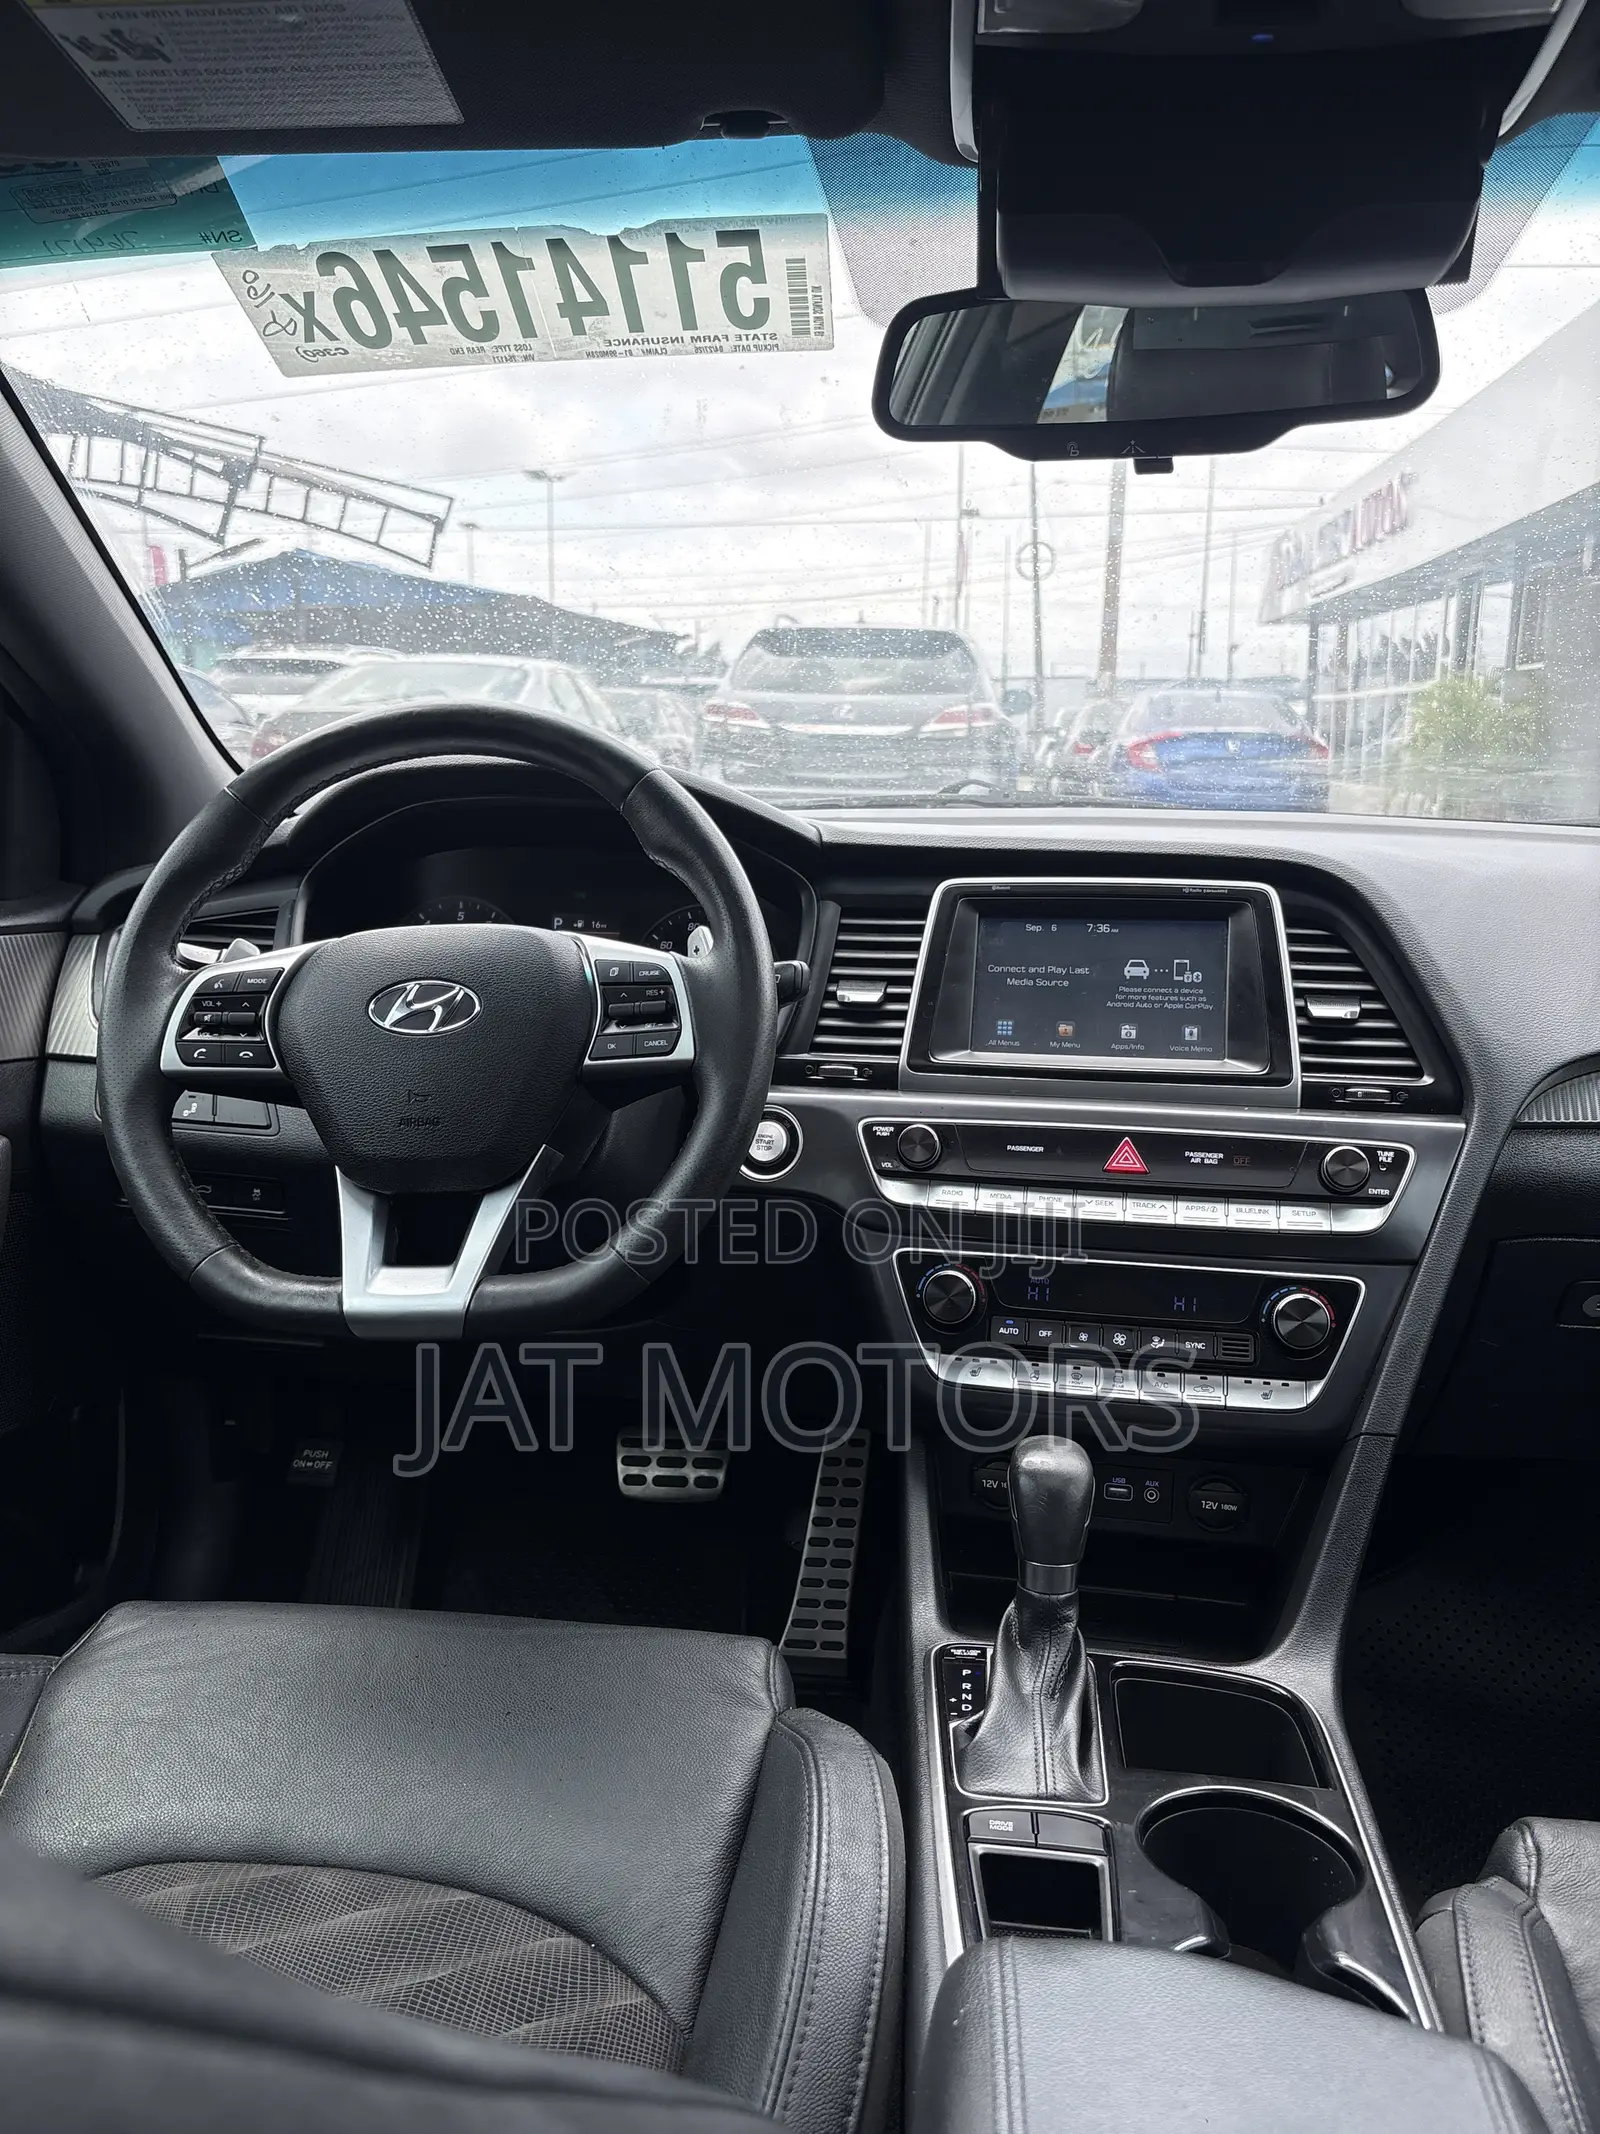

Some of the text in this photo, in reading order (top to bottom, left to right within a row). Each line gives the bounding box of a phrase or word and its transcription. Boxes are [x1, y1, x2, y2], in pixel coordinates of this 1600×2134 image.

[456, 911, 465, 921] 5
[553, 917, 563, 929] P
[1025, 923, 1057, 933] Sep. 6
[1086, 923, 1110, 933] 7:36
[660, 940, 673, 950] 60
[988, 964, 1090, 975] Connect and Play Last
[1006, 977, 1069, 987] Media Source
[1179, 994, 1196, 1002] such
[1135, 1001, 1153, 1009] Auto
[1163, 1002, 1184, 1010] Apple
[987, 1038, 1021, 1048] All Menus
[1111, 1043, 1145, 1051] Apps/Info
[1007, 1145, 1044, 1153] PASSENGER
[1184, 1151, 1224, 1159] PASSENGER
[941, 1189, 963, 1197] RADIO
[1368, 1188, 1390, 1196] ENTER
[1131, 1201, 1157, 1209] TRACK
[1236, 1207, 1270, 1215] BLUELINK
[1291, 1209, 1317, 1217] SETUP
[998, 1327, 1019, 1335] AUTO
[1185, 1341, 1206, 1350] SYNC
[1153, 1381, 1170, 1389] A/C
[303, 1449, 329, 1459] PUSH
[293, 1459, 333, 1470] ON OFF
[982, 1479, 999, 1489] 12V
[1145, 1480, 1159, 1488] AUX
[1201, 1500, 1238, 1512] 12V 180W
[962, 1682, 972, 1690] R
[962, 1693, 972, 1701] N
